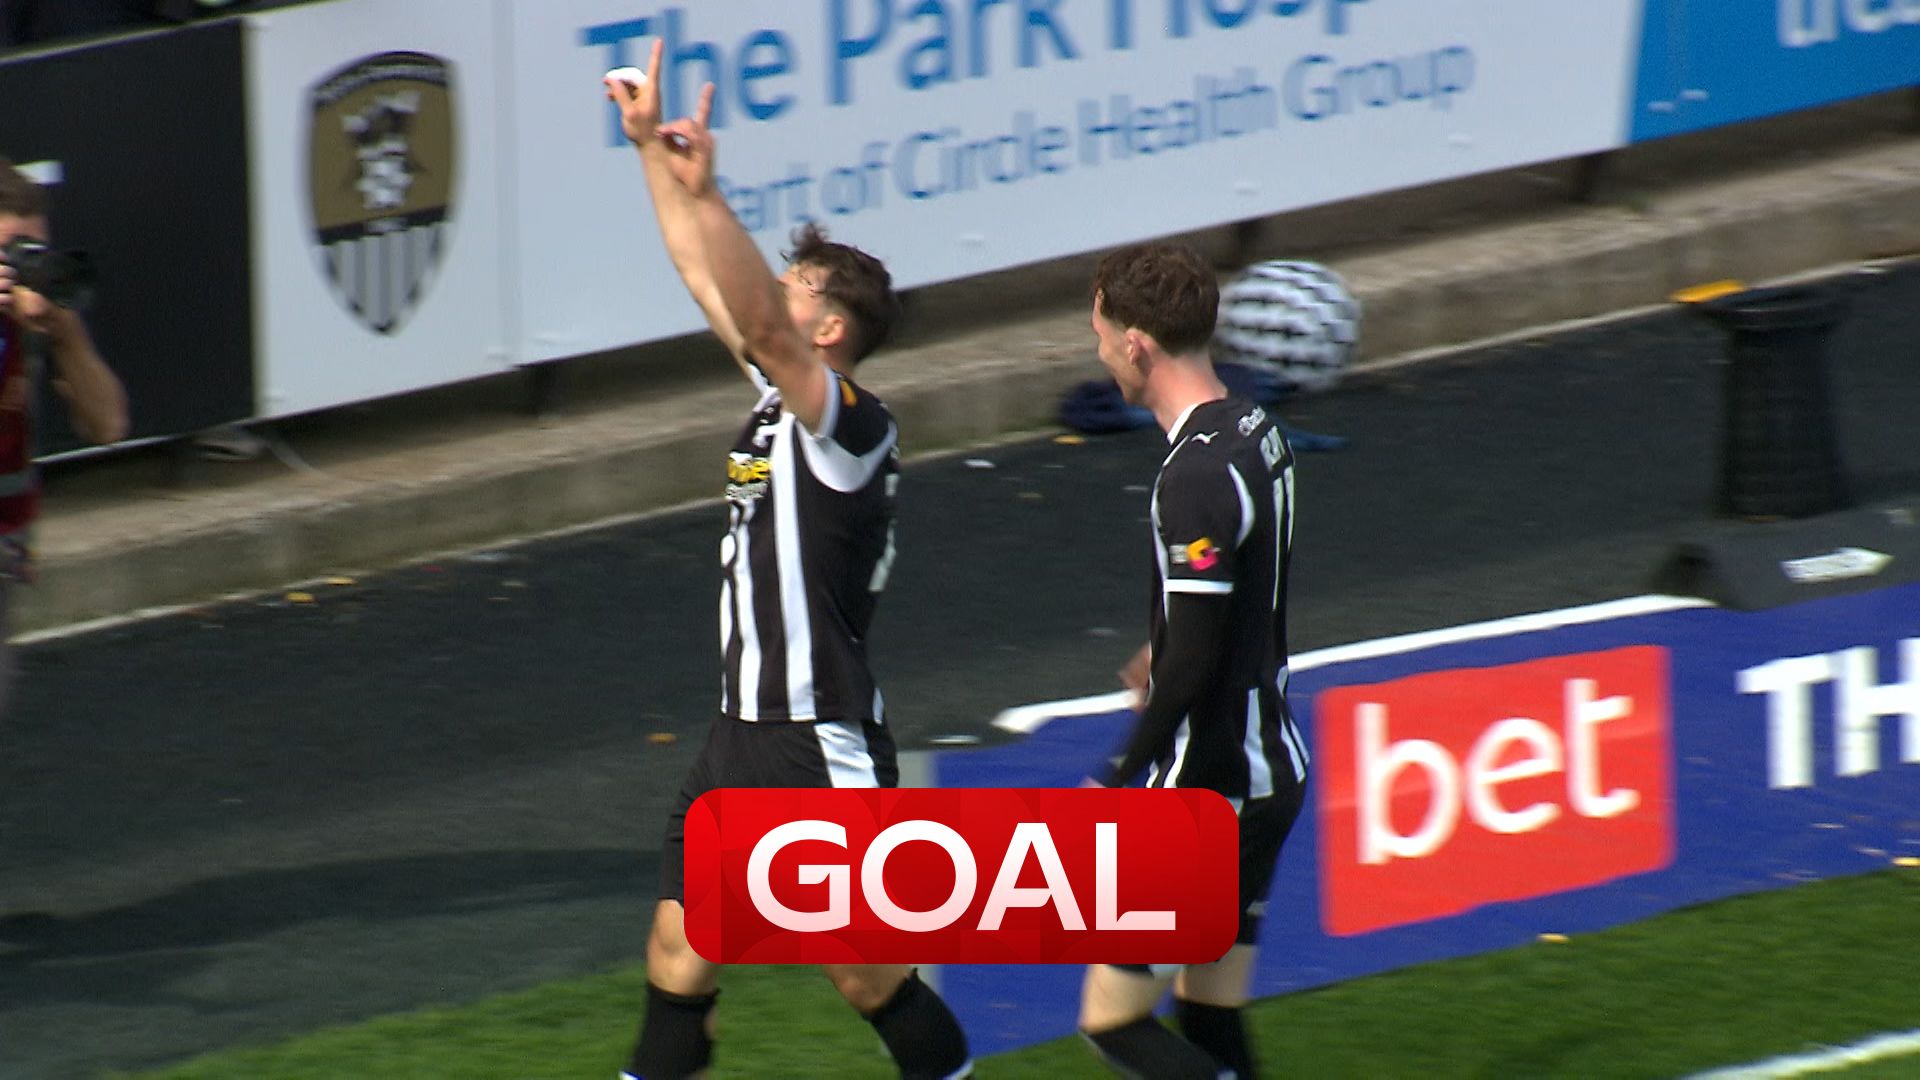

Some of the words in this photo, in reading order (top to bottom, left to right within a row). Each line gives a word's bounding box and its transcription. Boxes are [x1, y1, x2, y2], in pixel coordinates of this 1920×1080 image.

[580, 8, 796, 148] The
[827, 0, 1080, 106] Park
[714, 160, 813, 232] art
[822, 141, 891, 214] of
[893, 111, 1067, 200] Circle
[1077, 68, 1278, 166] Health
[1282, 46, 1475, 121] Group
[1354, 677, 1641, 865] bet
[1736, 637, 1920, 788] TH
